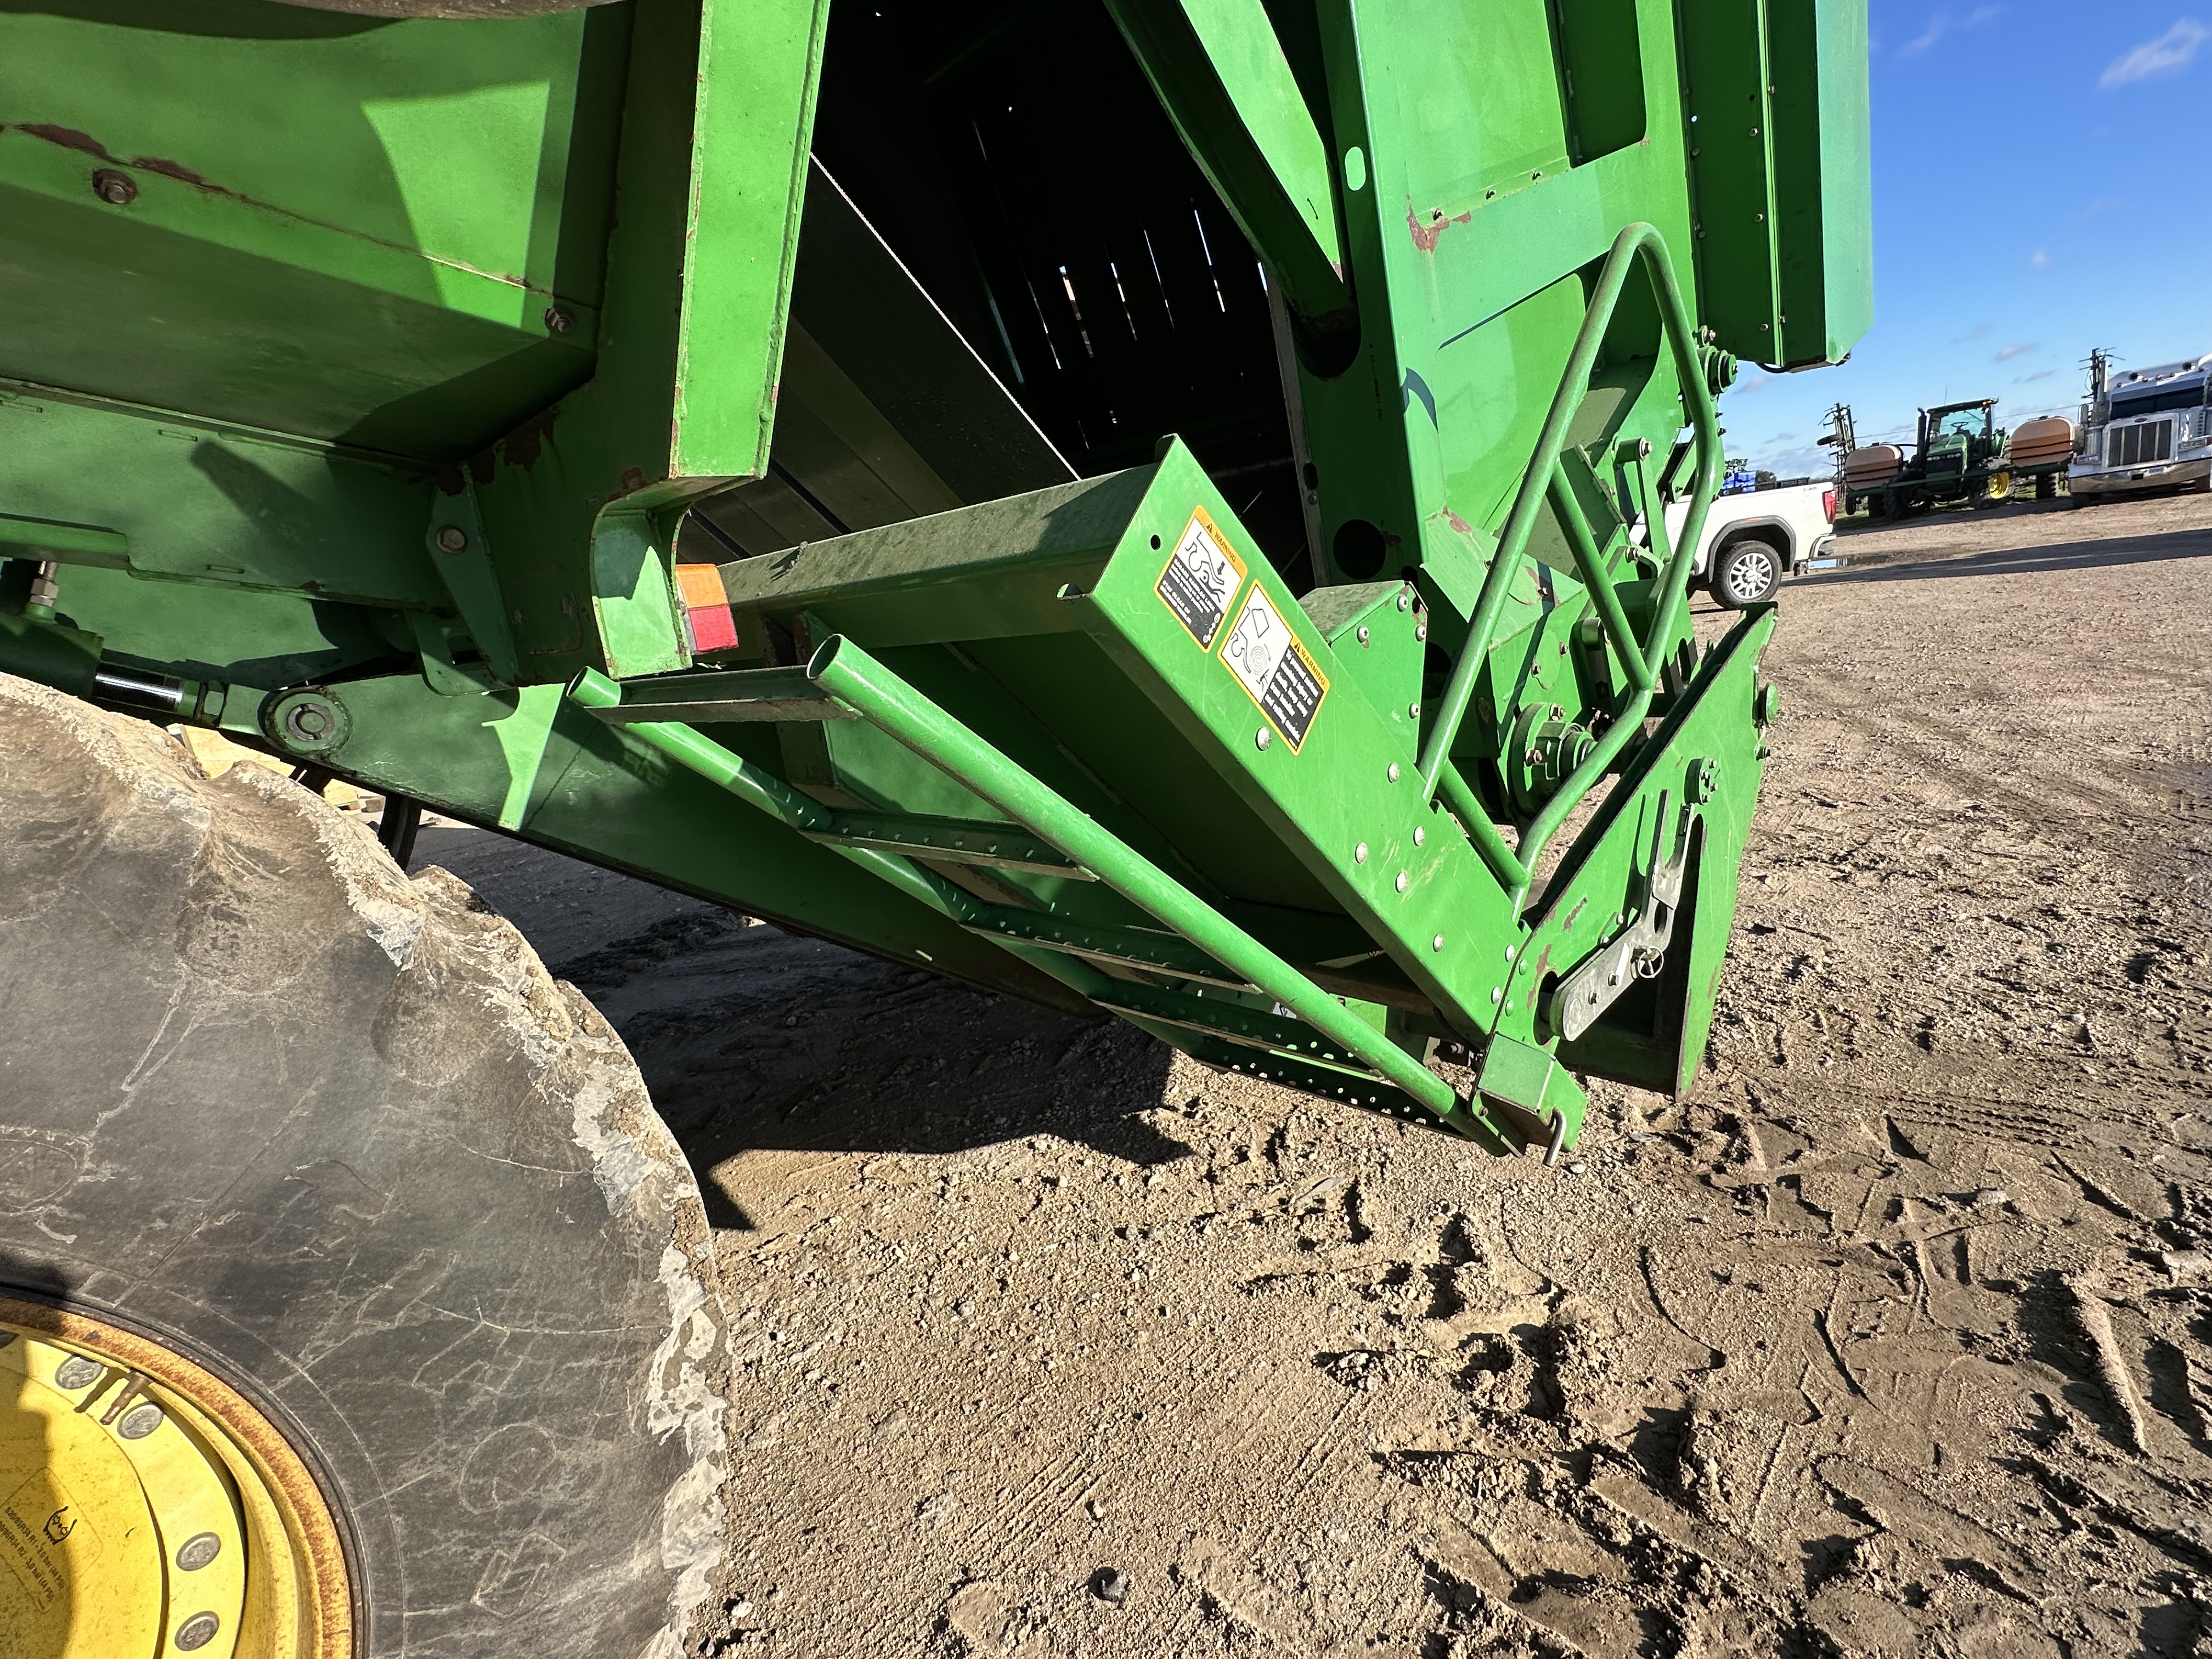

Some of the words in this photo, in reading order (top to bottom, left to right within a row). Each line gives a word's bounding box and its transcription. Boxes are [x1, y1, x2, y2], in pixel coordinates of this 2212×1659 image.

[1215, 532, 1235, 562] WARNING
[1162, 580, 1172, 592] STAY
[1172, 591, 1184, 607] CLEAR
[1280, 661, 1297, 686] crushing
[1296, 681, 1308, 701] injury
[1285, 649, 1293, 660] To
[1289, 657, 1306, 679] prevent
[1304, 676, 1318, 697] serious
[1301, 650, 1325, 685] WARNING
[1269, 681, 1280, 698] from
[1275, 672, 1288, 692] death,
[1287, 687, 1297, 703] keep
[1296, 701, 1307, 717] away
[1265, 693, 1274, 706] and
[1272, 703, 1286, 724] rolling
